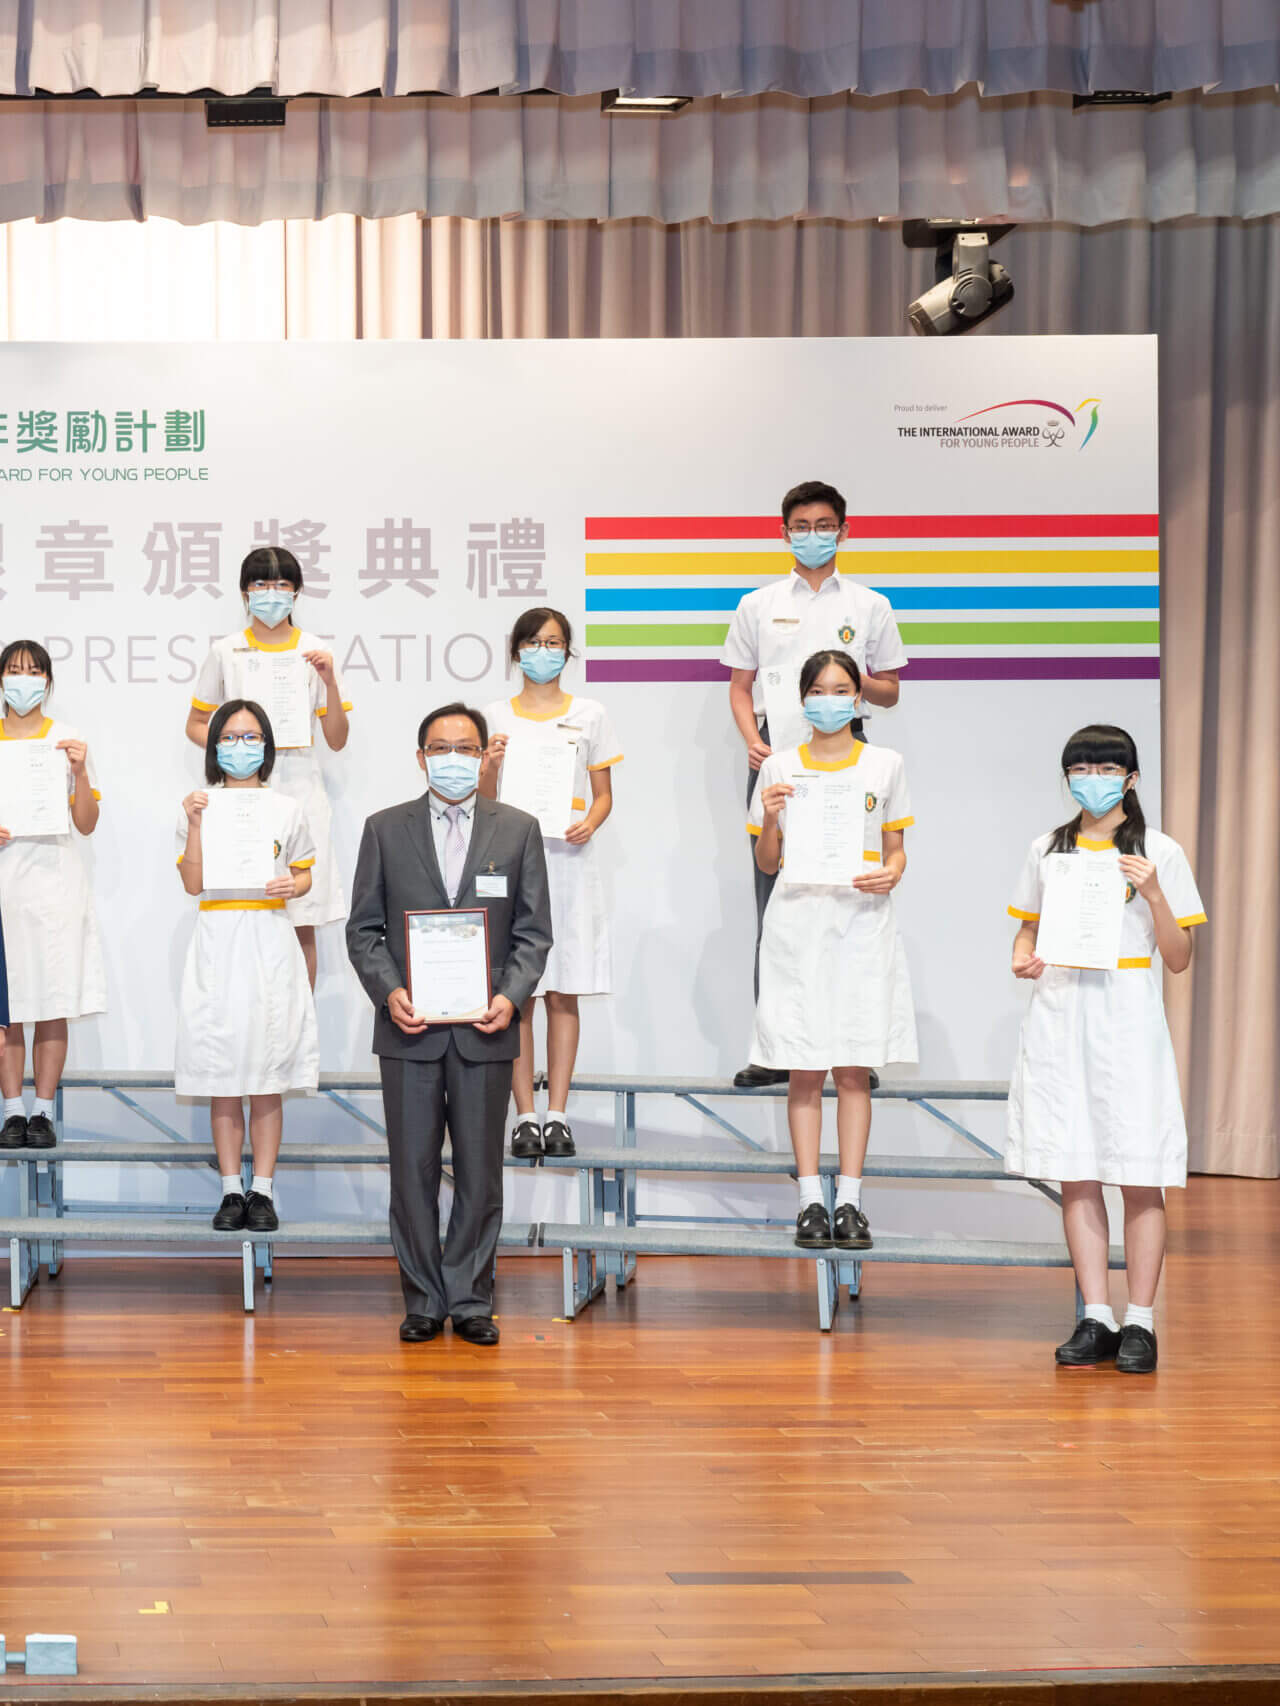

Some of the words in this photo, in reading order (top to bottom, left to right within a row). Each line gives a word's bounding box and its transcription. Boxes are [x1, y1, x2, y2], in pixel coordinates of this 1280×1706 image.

[893, 403, 915, 413] Proud
[916, 403, 923, 413] to
[923, 403, 948, 413] deliver
[897, 427, 918, 437] THE
[919, 427, 1000, 437] INTERNATIONAL
[1001, 426, 1040, 437] AWARD
[940, 438, 961, 448] FOR
[961, 438, 999, 448] YOUNG
[1000, 438, 1039, 448] PEOPLE
[38, 467, 73, 482] FOR
[80, 467, 139, 482] YOUNG
[144, 467, 209, 481] PEOPLE
[42, 632, 513, 685] PRESATIO
